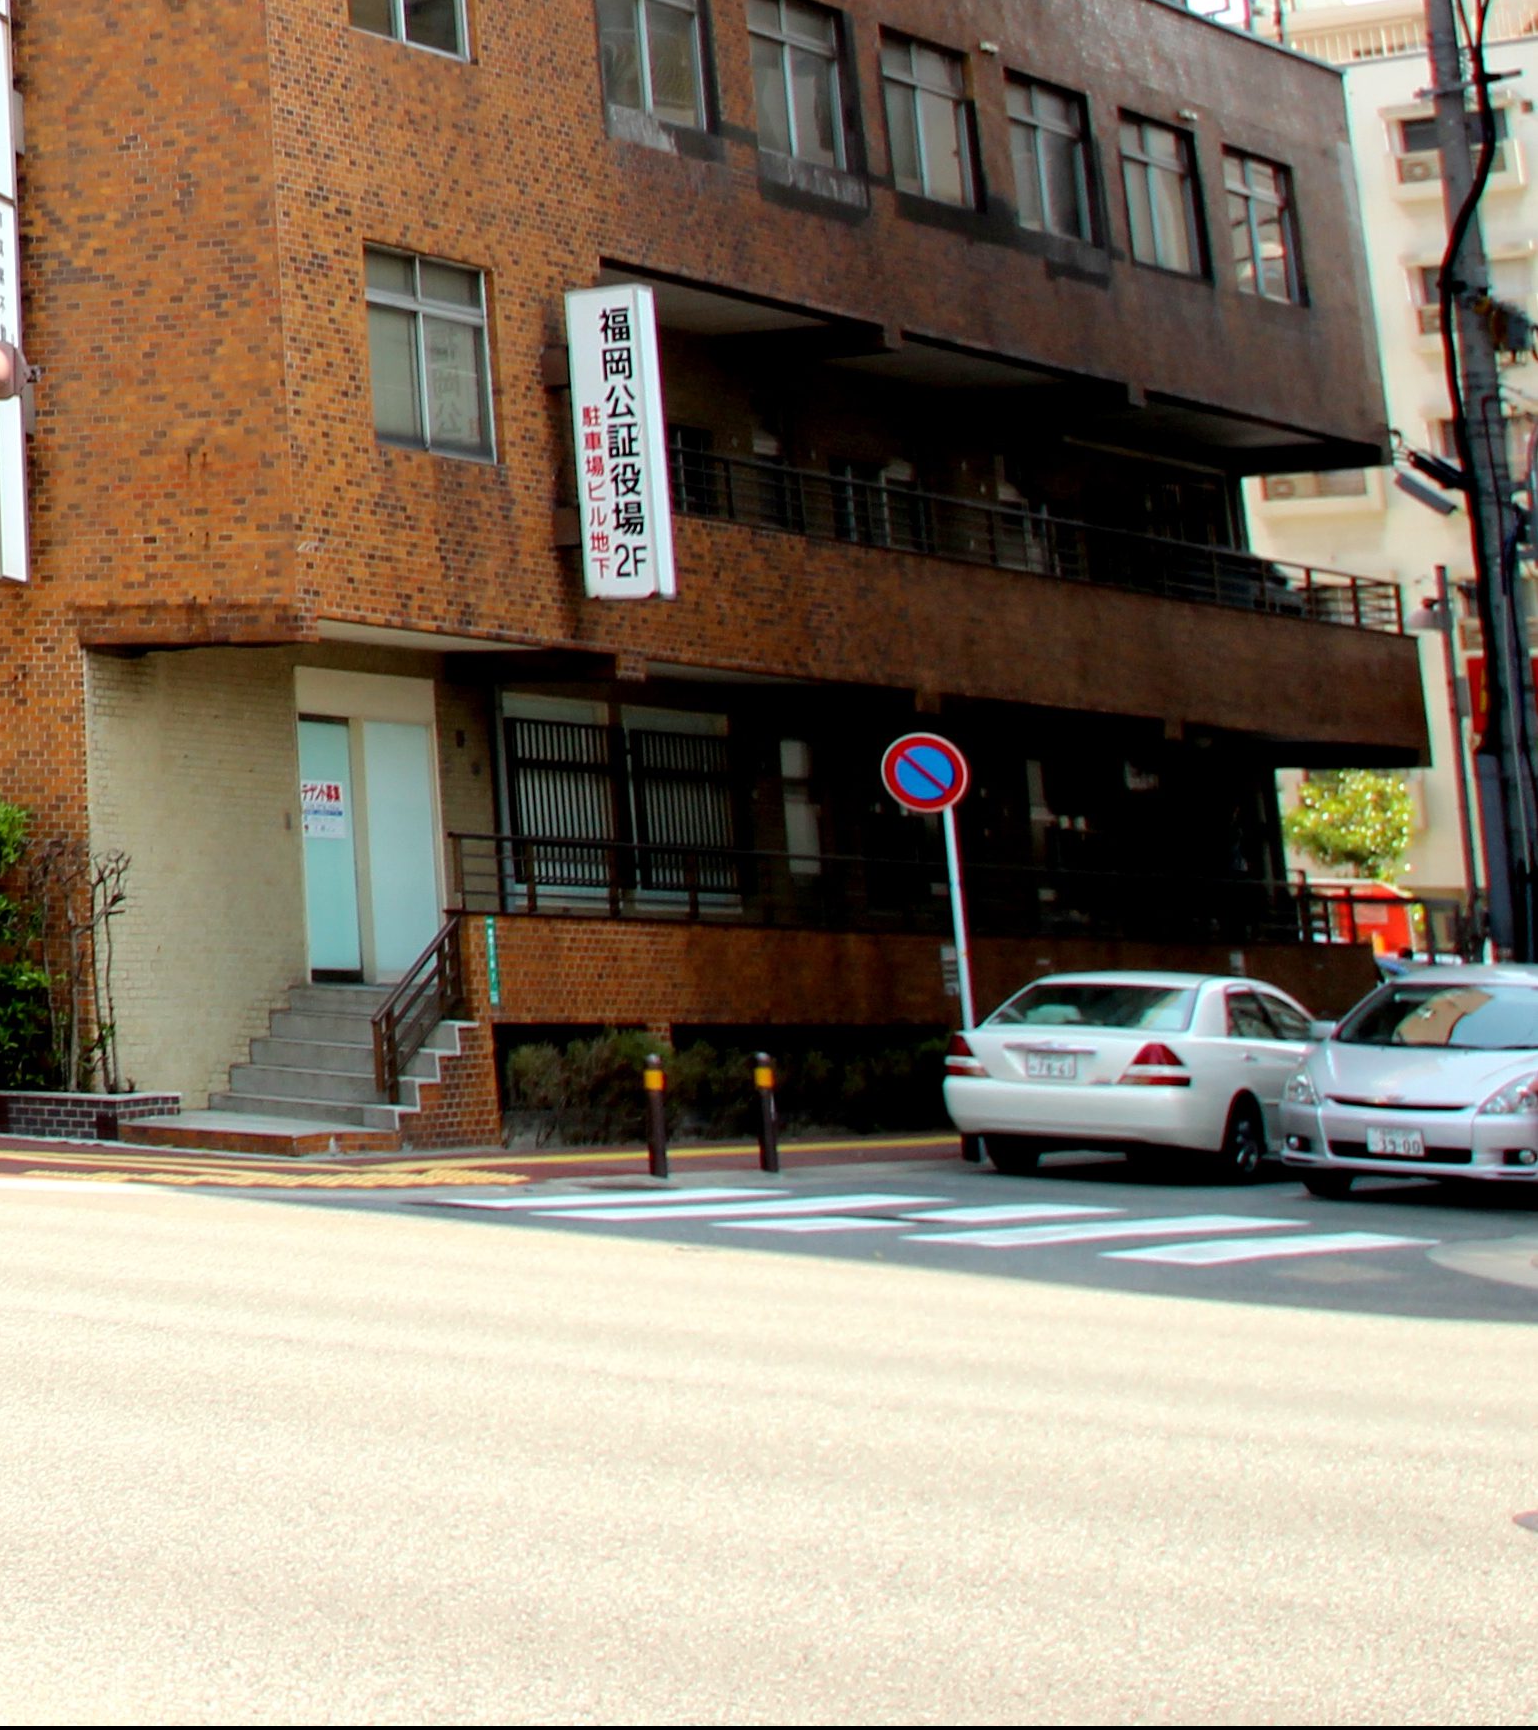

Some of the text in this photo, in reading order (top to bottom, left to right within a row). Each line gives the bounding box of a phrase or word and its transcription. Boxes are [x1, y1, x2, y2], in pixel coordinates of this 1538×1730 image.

[582, 405, 612, 579] 駐車場ビル地下
